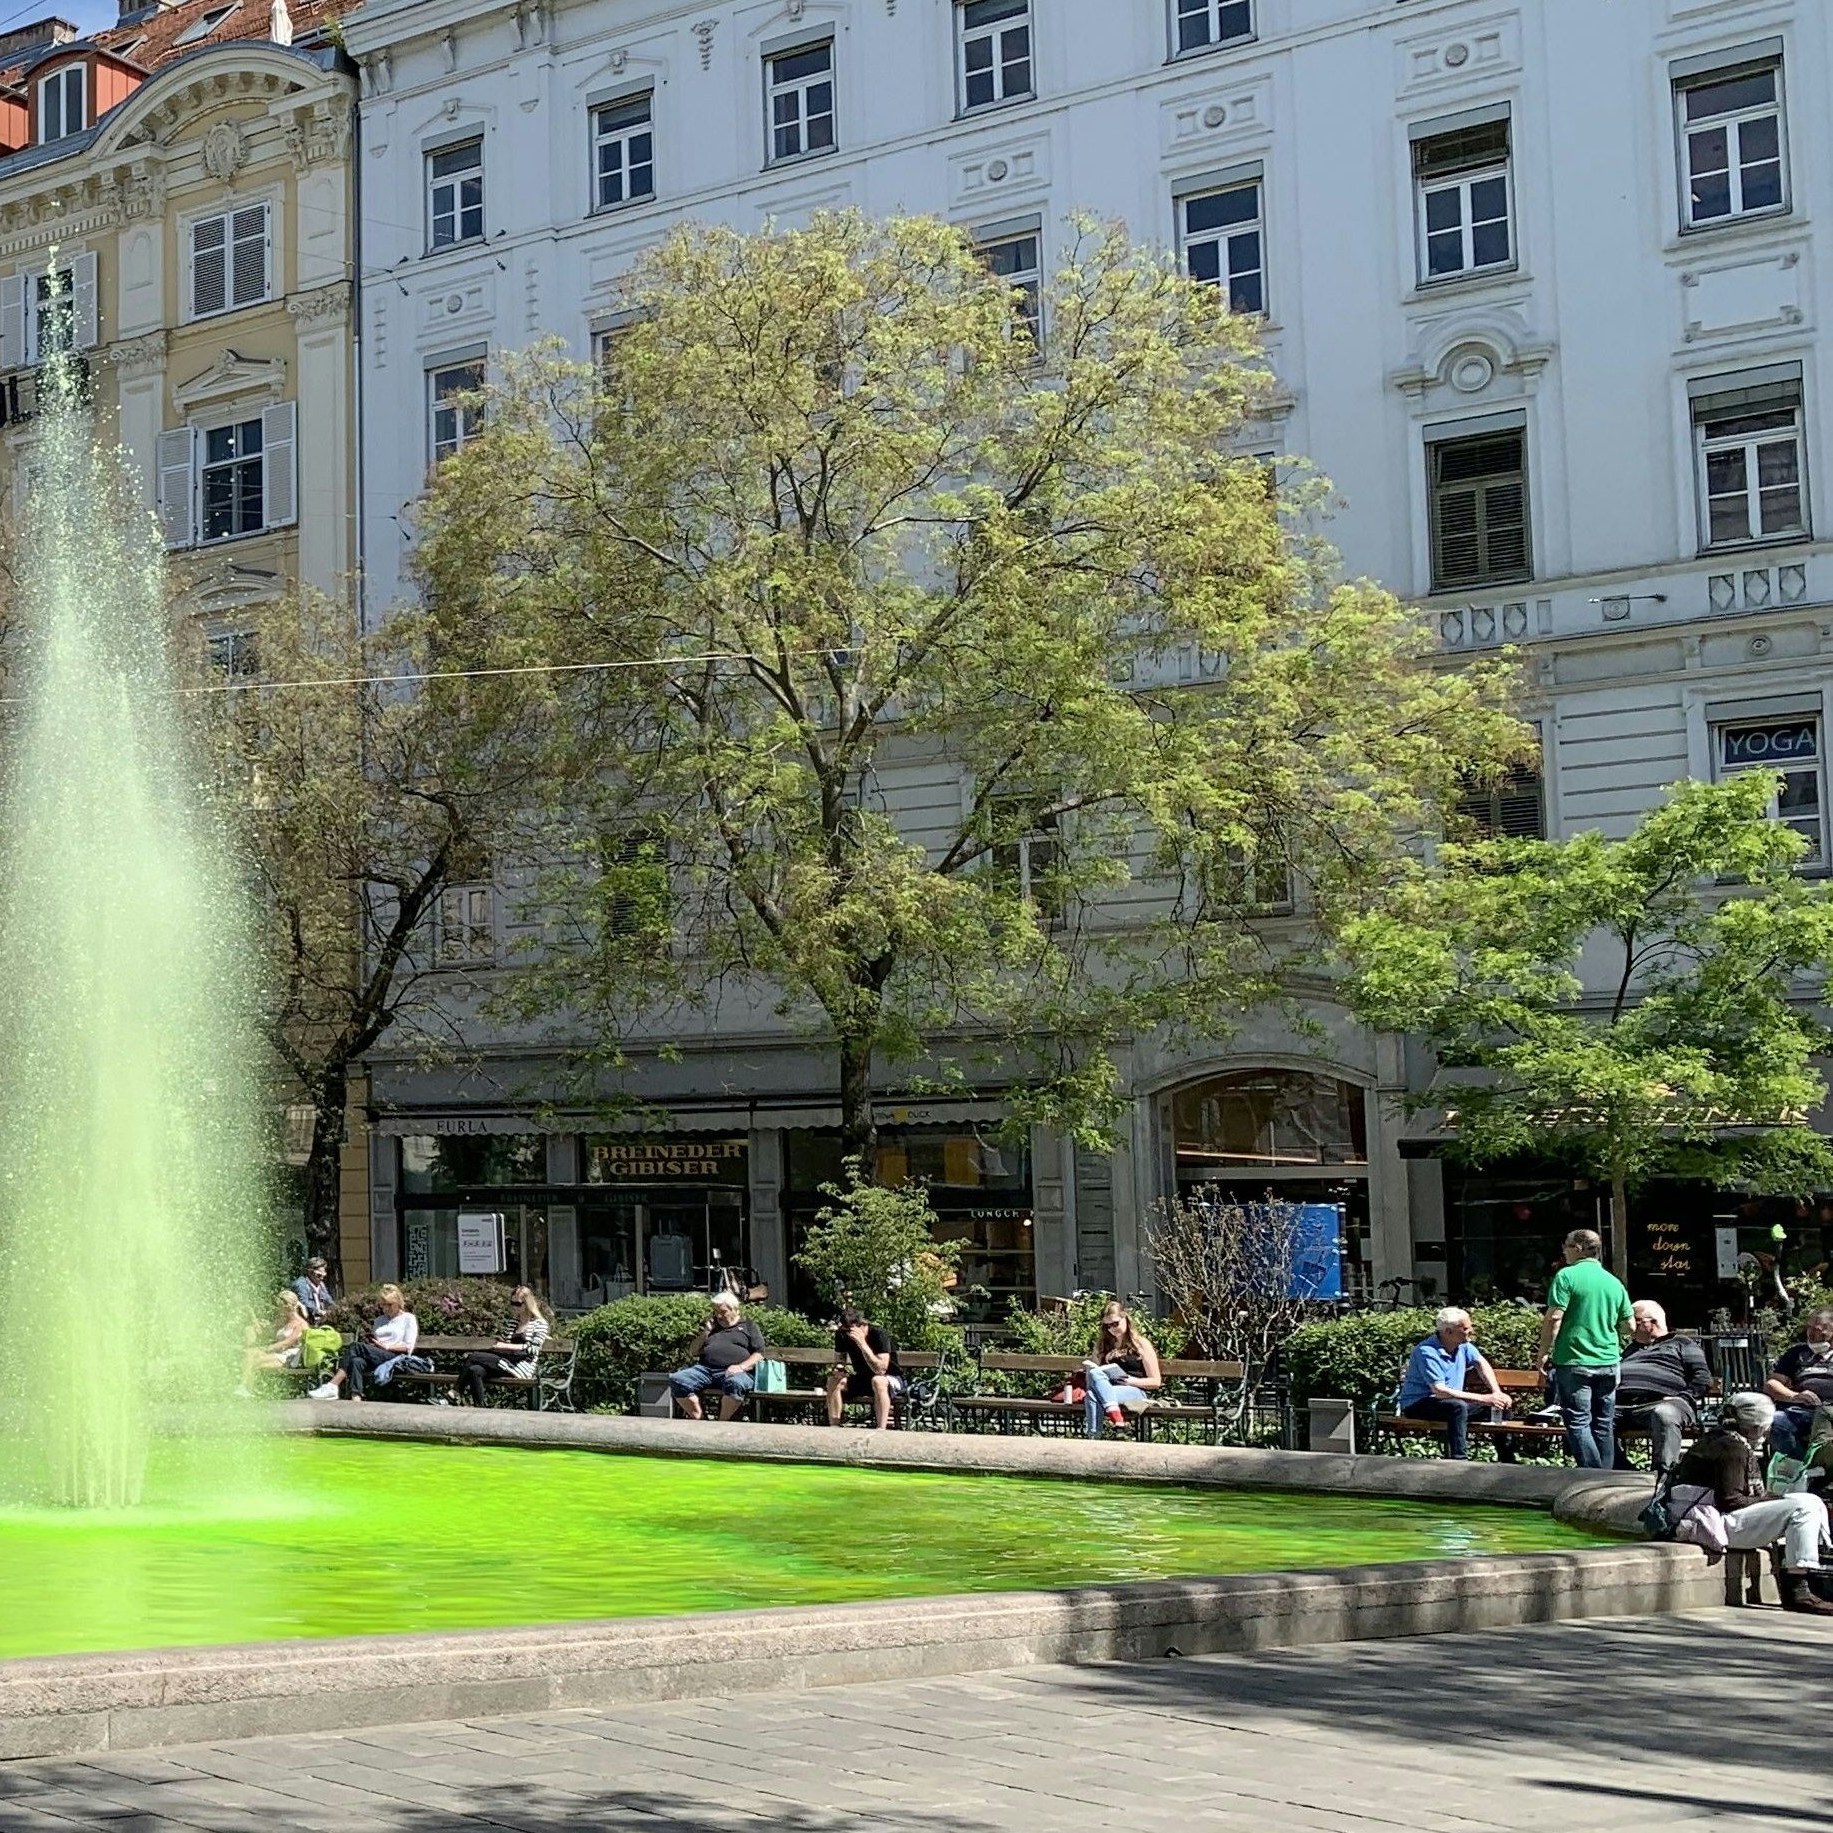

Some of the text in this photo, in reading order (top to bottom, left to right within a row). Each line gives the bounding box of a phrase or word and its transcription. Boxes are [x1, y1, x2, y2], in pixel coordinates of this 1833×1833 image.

[1728, 728, 1815, 755] YOGA
[436, 1120, 487, 1133] FURLA
[592, 1144, 742, 1159] BREINEDER
[609, 1161, 720, 1175] GIBISER
